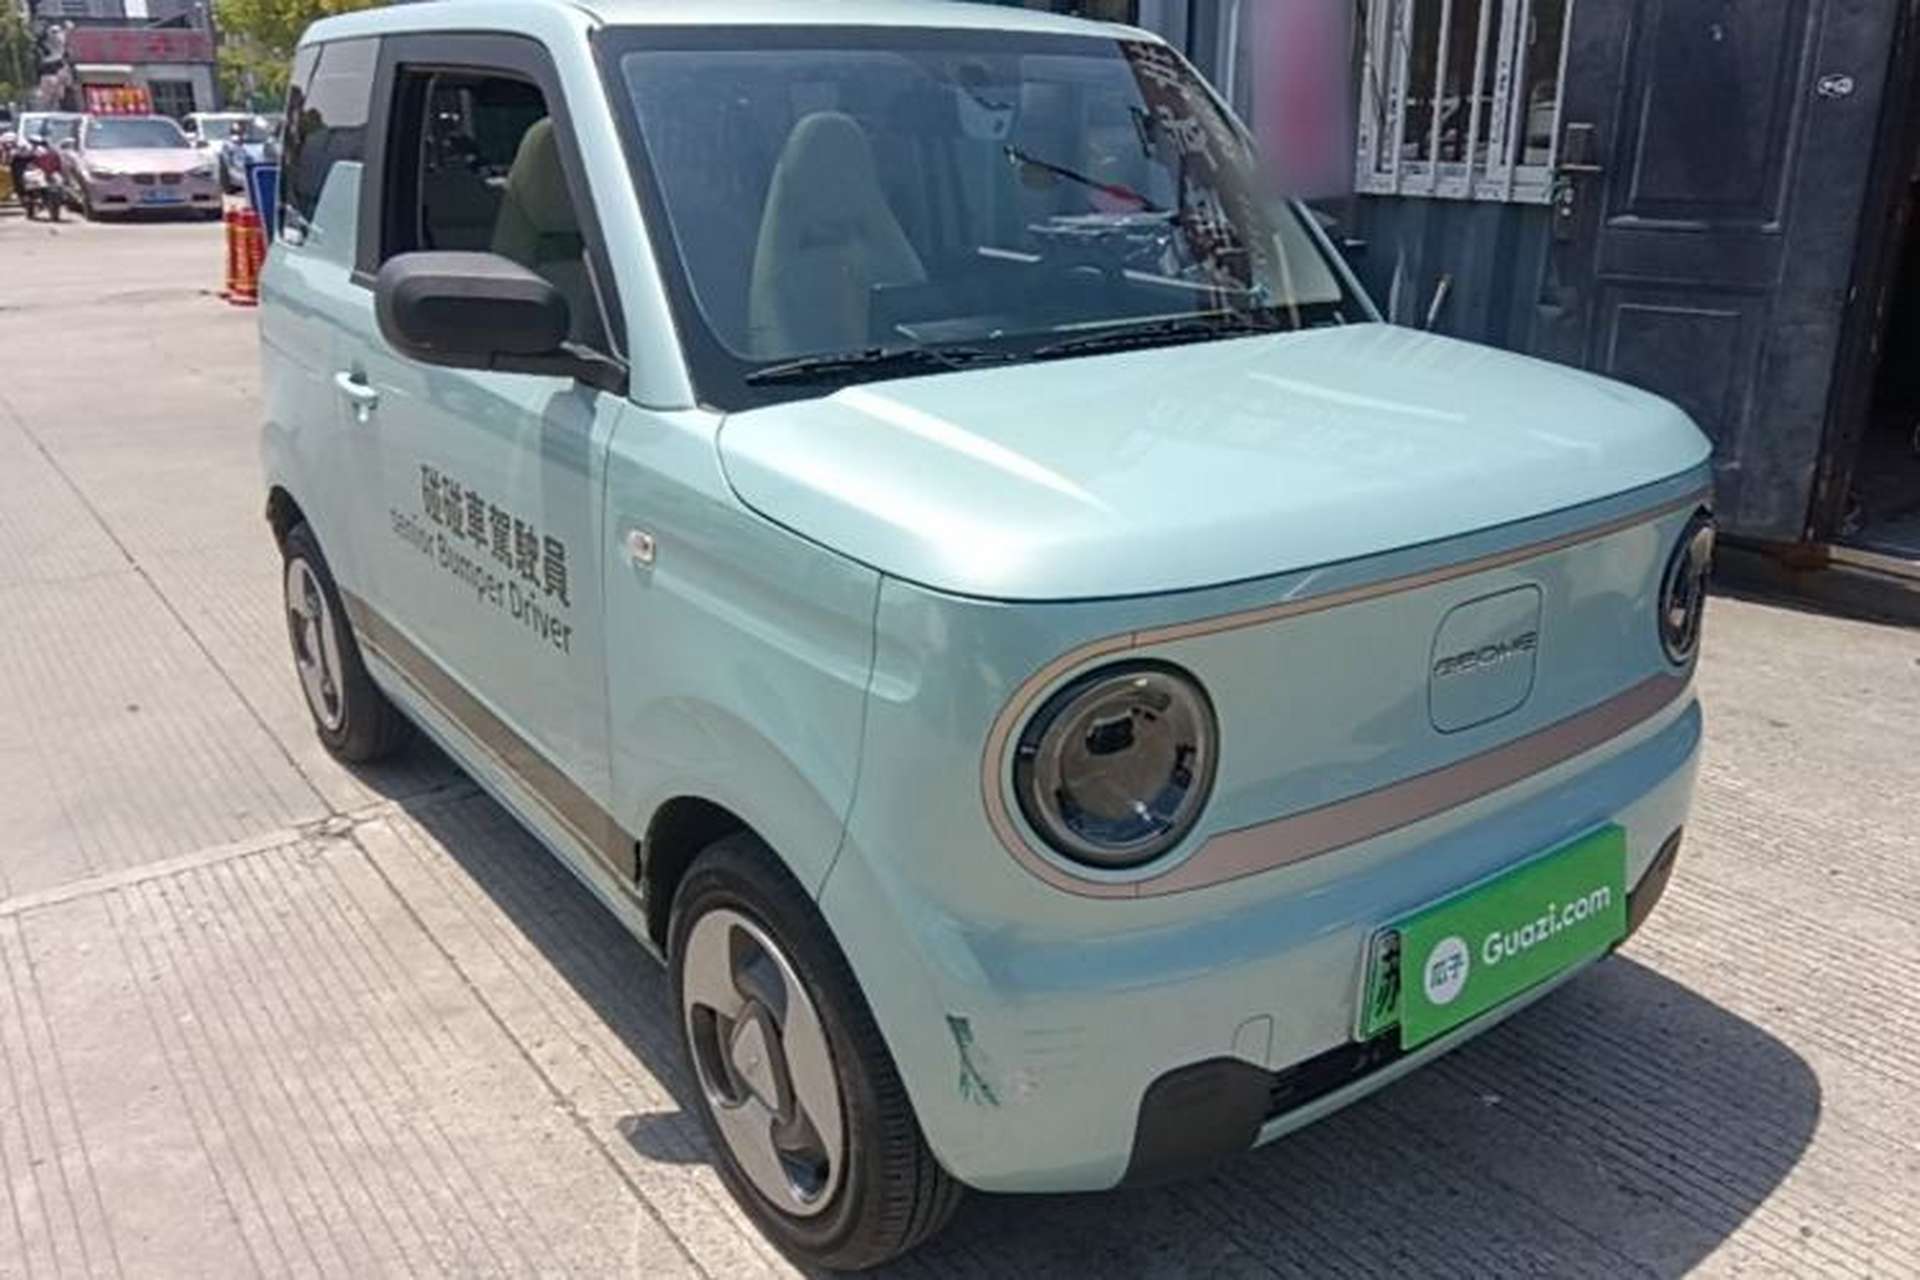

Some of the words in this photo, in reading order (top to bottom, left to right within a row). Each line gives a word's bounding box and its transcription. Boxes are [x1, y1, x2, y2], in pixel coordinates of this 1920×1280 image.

[436, 533, 504, 606] Bumper
[508, 579, 573, 656] Driver
[1482, 886, 1612, 966] Guazi.com
